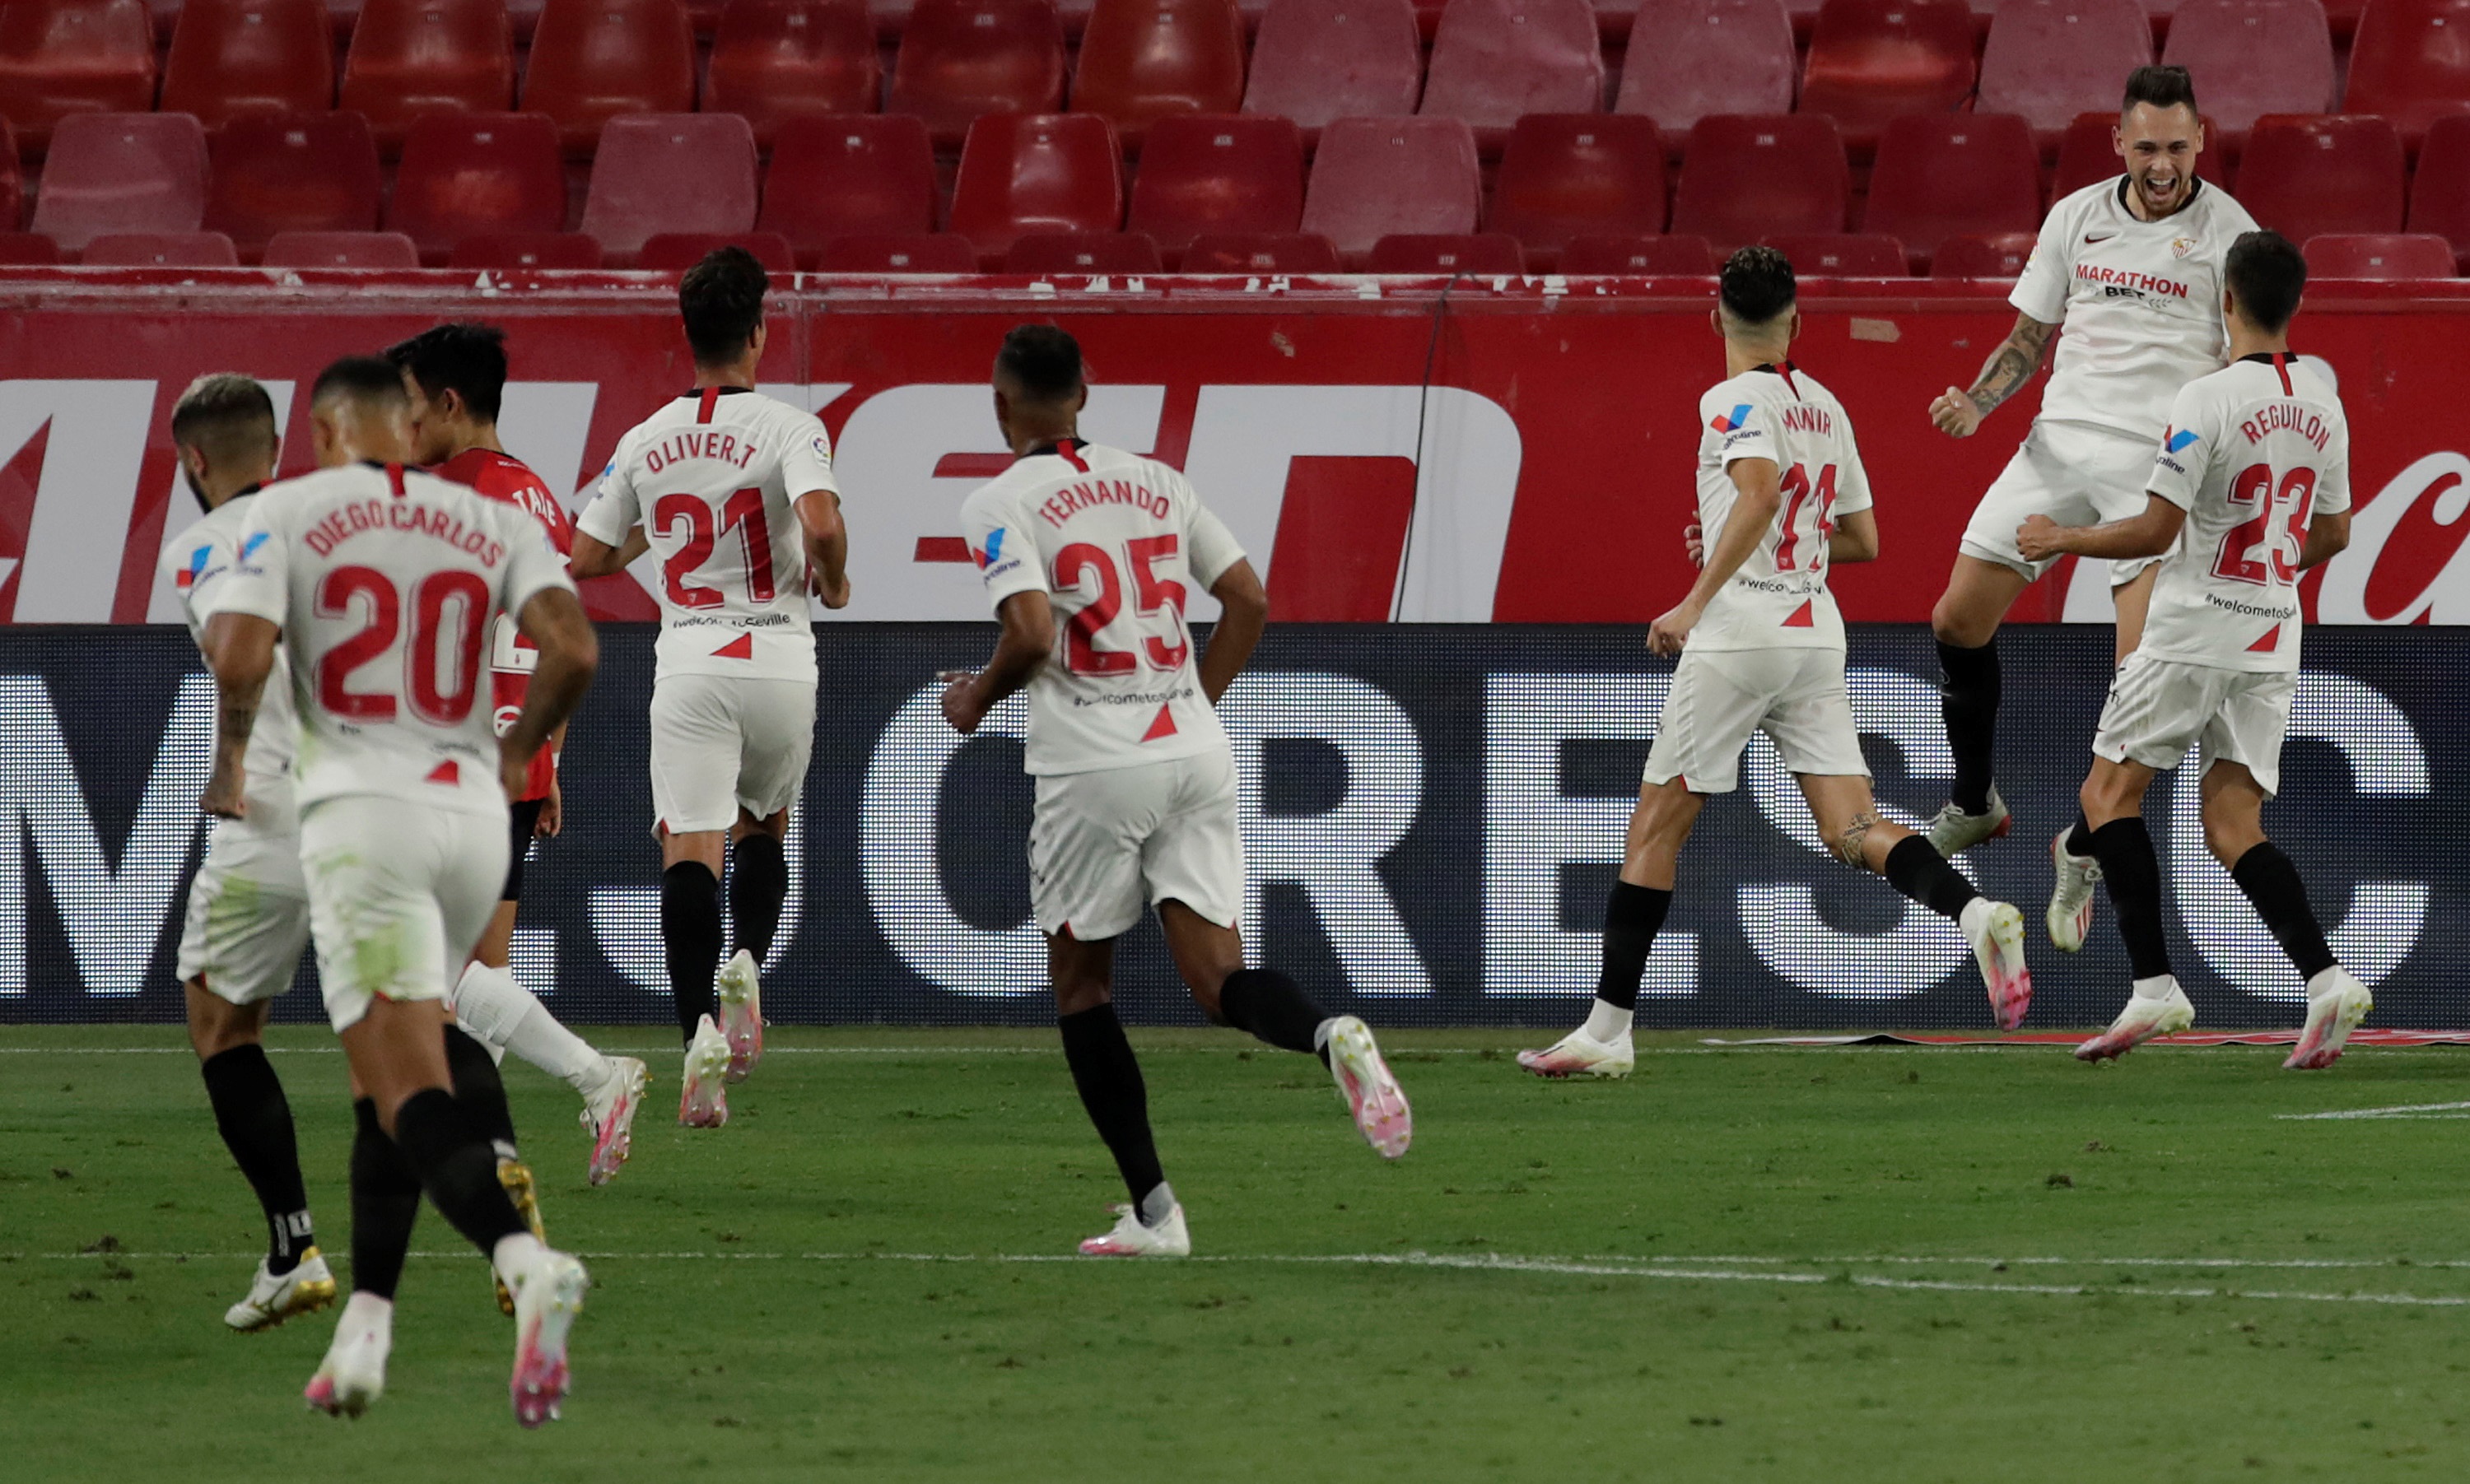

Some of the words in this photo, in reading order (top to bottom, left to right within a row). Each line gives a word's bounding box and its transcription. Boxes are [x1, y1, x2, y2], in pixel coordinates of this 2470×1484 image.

[2076, 263, 2188, 299] MARATHON
[2104, 286, 2146, 300] BET
[1780, 406, 1831, 438] MUNIR
[2240, 404, 2331, 454] REGUILÓN
[646, 433, 757, 474] OLIVER.T
[1038, 480, 1170, 529] FERNANDO
[2209, 463, 2316, 588] 23
[650, 487, 776, 610] 21
[1049, 533, 1188, 677] 25
[312, 565, 489, 728] 20
[0, 668, 1978, 999] MORES
